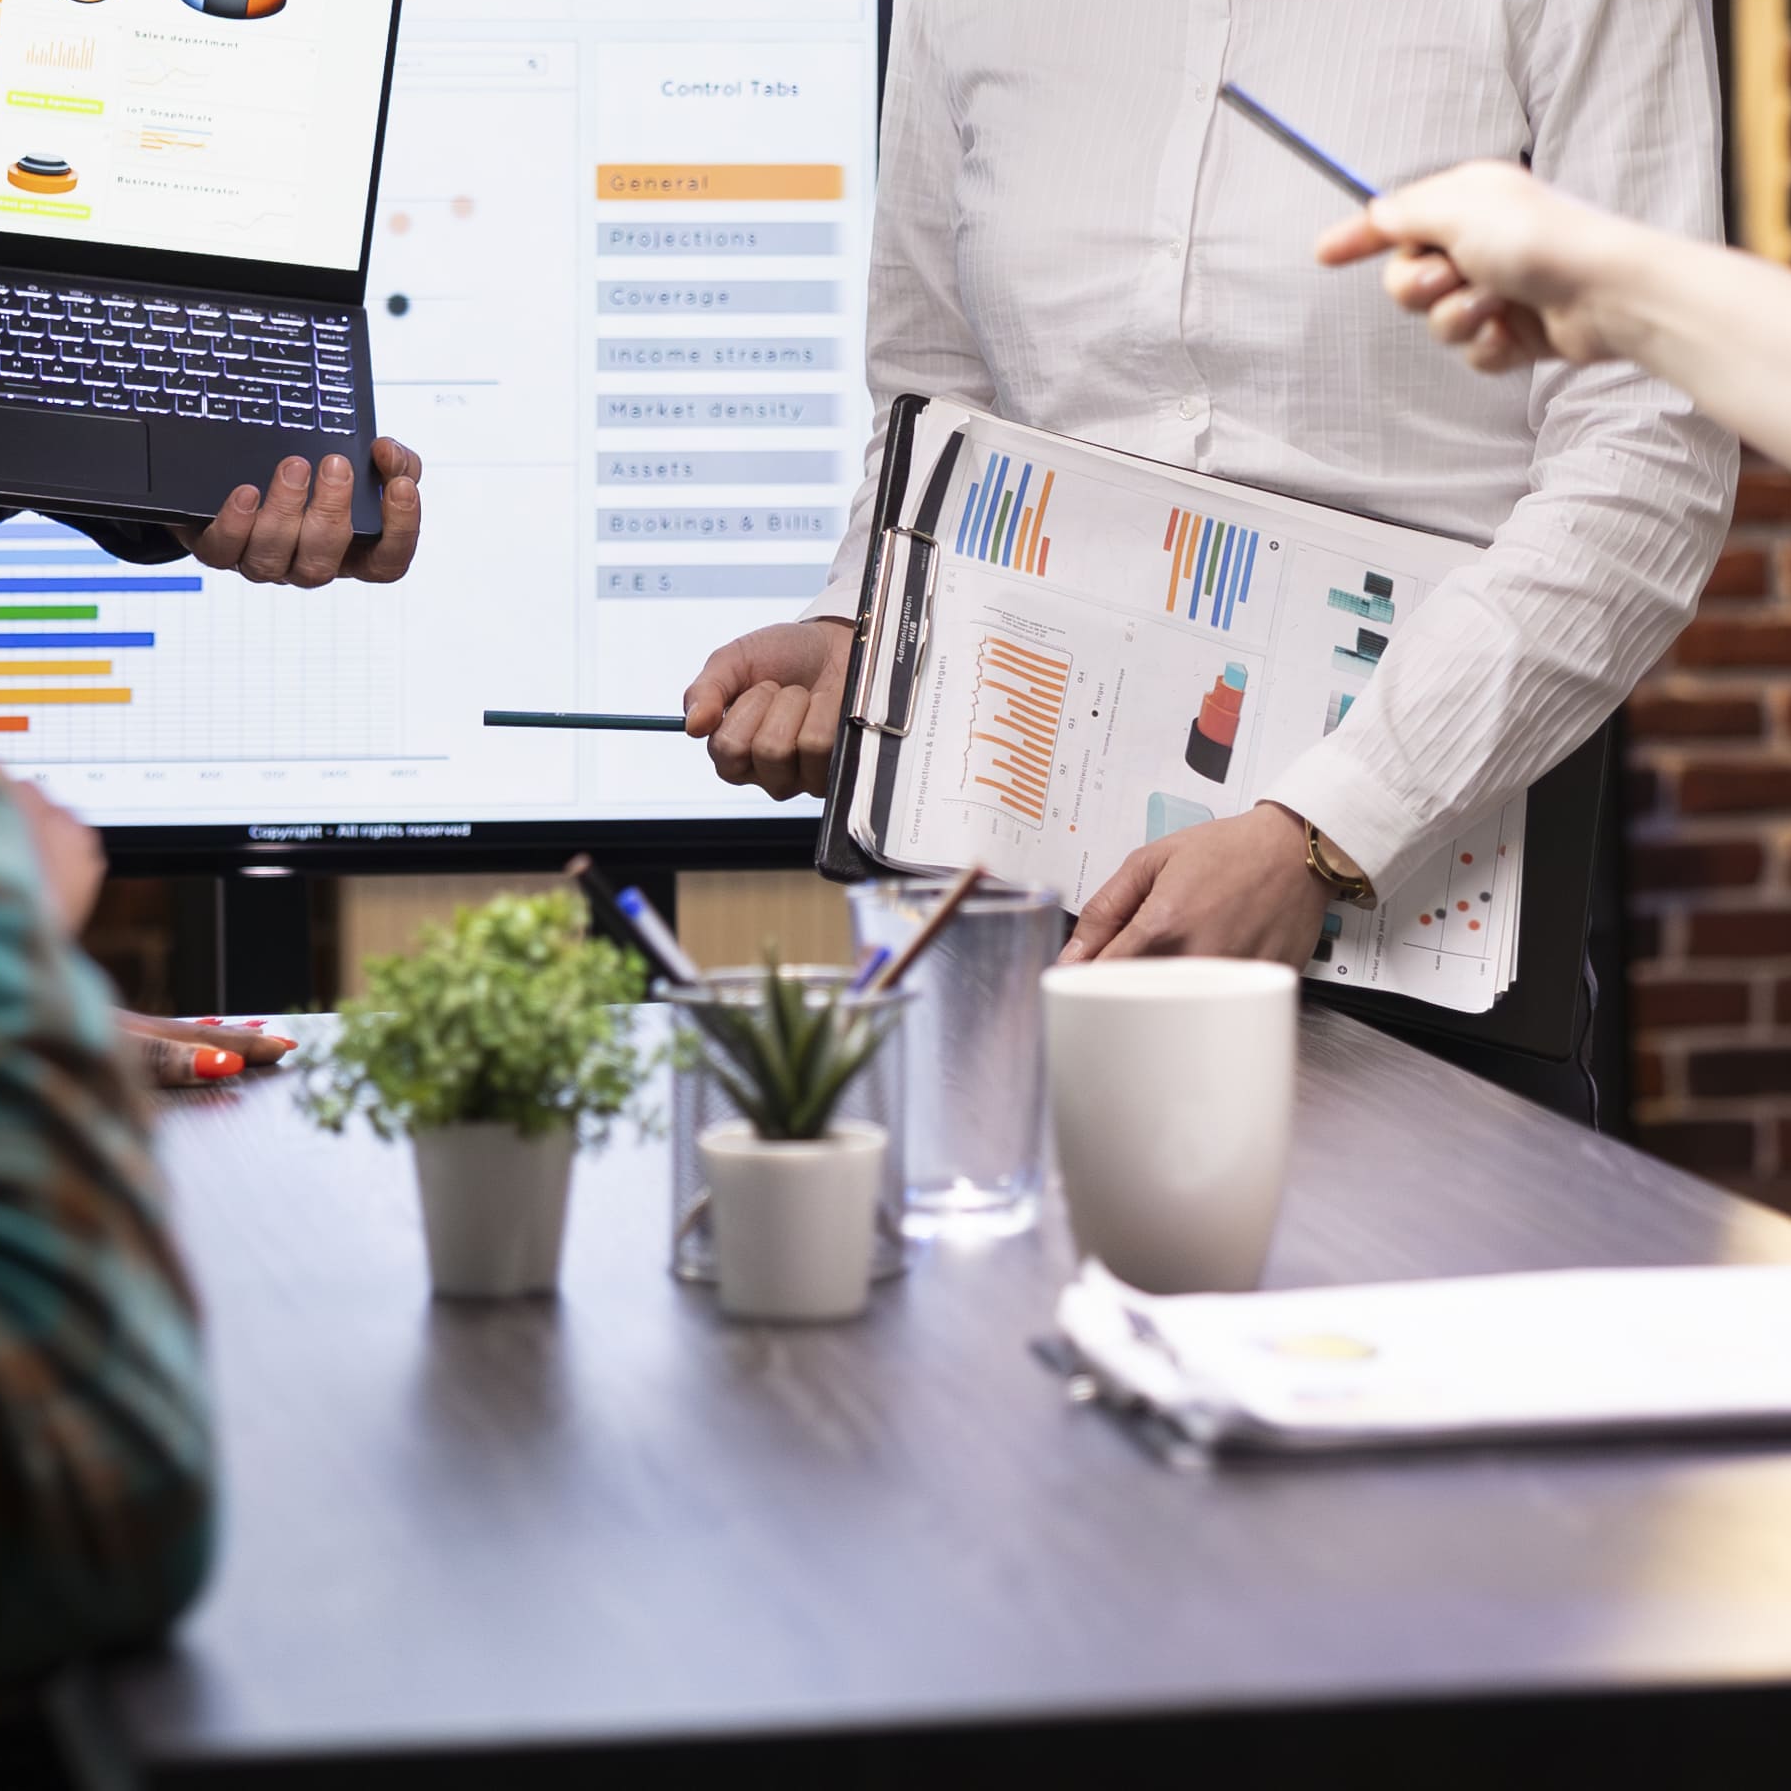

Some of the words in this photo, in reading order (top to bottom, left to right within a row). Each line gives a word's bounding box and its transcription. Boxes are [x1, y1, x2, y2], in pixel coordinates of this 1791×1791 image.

[135, 30, 165, 41] Sales
[170, 35, 239, 50] department
[660, 80, 742, 98] Control
[750, 79, 800, 98] Tabs
[117, 176, 168, 189] Business
[610, 175, 709, 191] General
[610, 228, 757, 249] Projections
[610, 288, 730, 308] Coverage
[609, 347, 700, 363] Income
[713, 347, 814, 363] streams
[610, 403, 695, 418] Market
[708, 402, 804, 423] density
[610, 462, 694, 478] Assets
[610, 514, 728, 535] Bookings
[767, 514, 822, 532] Bills
[896, 595, 913, 664] Administation
[907, 621, 918, 643] HUB
[1094, 682, 1105, 706] Target
[1059, 764, 1067, 776] Q2
[1068, 718, 1076, 730] Q3
[1077, 671, 1085, 684] Q4
[910, 809, 923, 844] Current
[917, 751, 933, 806] projections
[927, 694, 941, 738] Expected
[934, 657, 948, 691] targets
[1076, 748, 1090, 793] projections
[1071, 794, 1083, 823] Current
[248, 824, 322, 841] Copyright
[336, 824, 359, 838] All
[359, 824, 404, 840] rights
[405, 823, 471, 837] reserved
